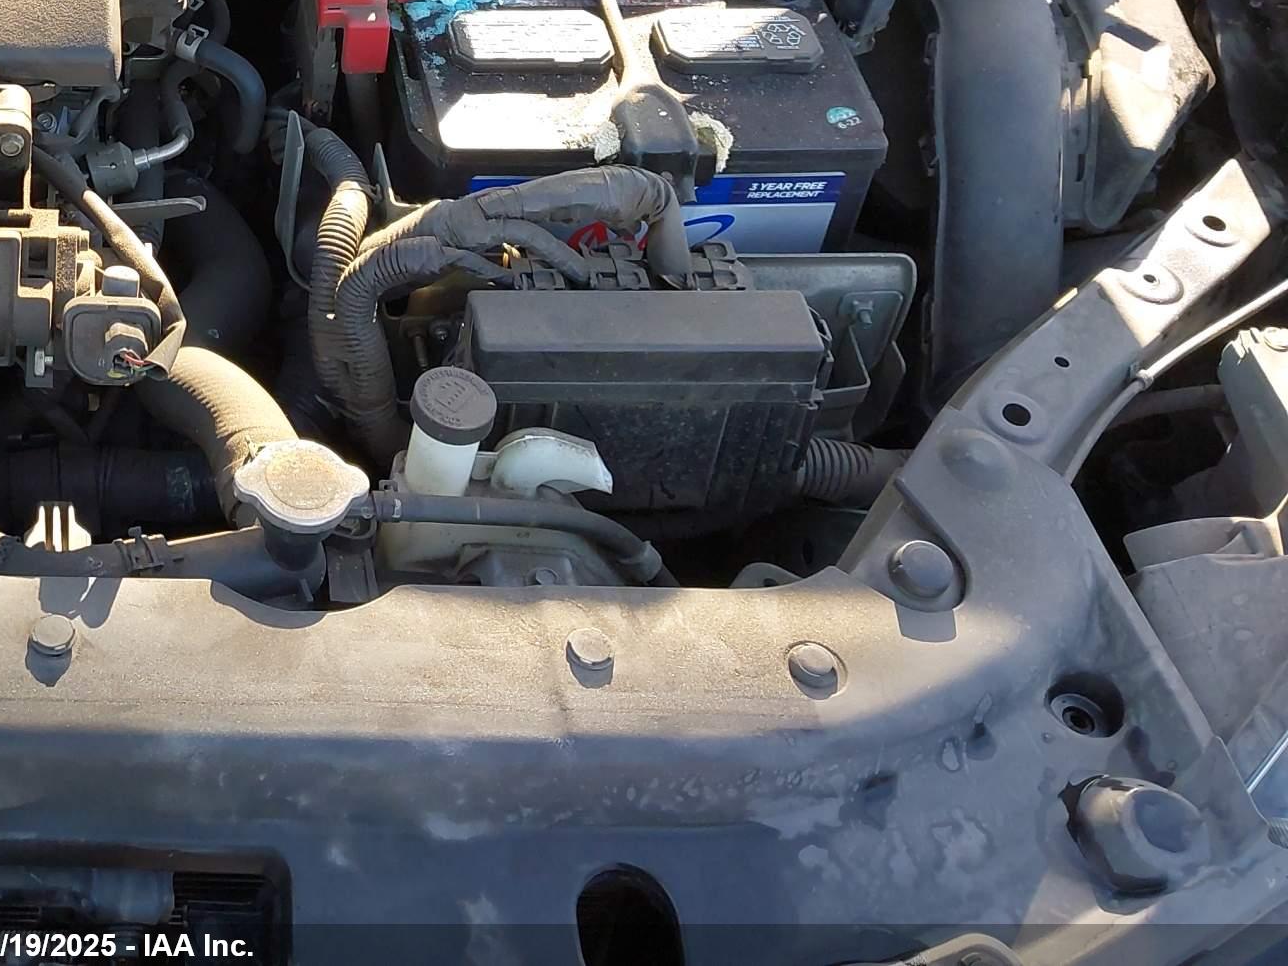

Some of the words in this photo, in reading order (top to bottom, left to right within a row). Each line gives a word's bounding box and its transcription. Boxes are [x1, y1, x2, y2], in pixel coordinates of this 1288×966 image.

[748, 182, 760, 191] 3
[760, 182, 794, 191] YEAR
[793, 181, 828, 190] FREE
